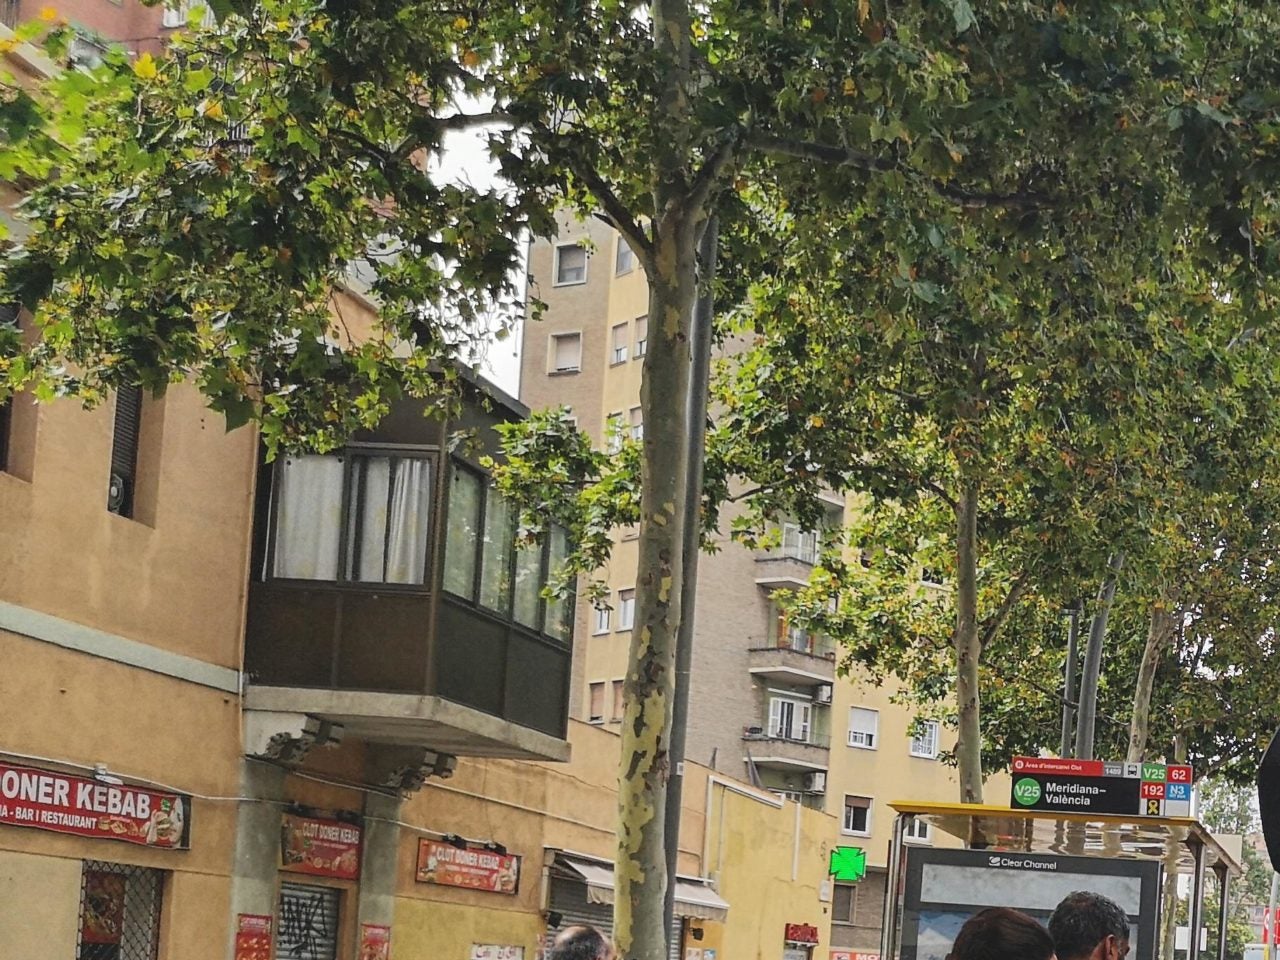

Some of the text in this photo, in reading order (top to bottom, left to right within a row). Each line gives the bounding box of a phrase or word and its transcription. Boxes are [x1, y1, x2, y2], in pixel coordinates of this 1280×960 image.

[1143, 768, 1165, 780] V25
[1172, 769, 1186, 780] 62
[0, 770, 150, 819] ONER KEBAB
[1016, 784, 1040, 797] V25
[1143, 785, 1164, 796] 192
[1170, 785, 1185, 795] N3
[1045, 794, 1091, 805] València
[15, 806, 34, 821] BAR
[42, 811, 98, 830] RESTAURANT
[303, 822, 360, 844] CLOT DONER KEBAB
[436, 847, 455, 863] CLOT
[455, 850, 478, 867] DONER
[479, 854, 499, 870] KEBAB
[1001, 857, 1057, 870] Clear Channel
